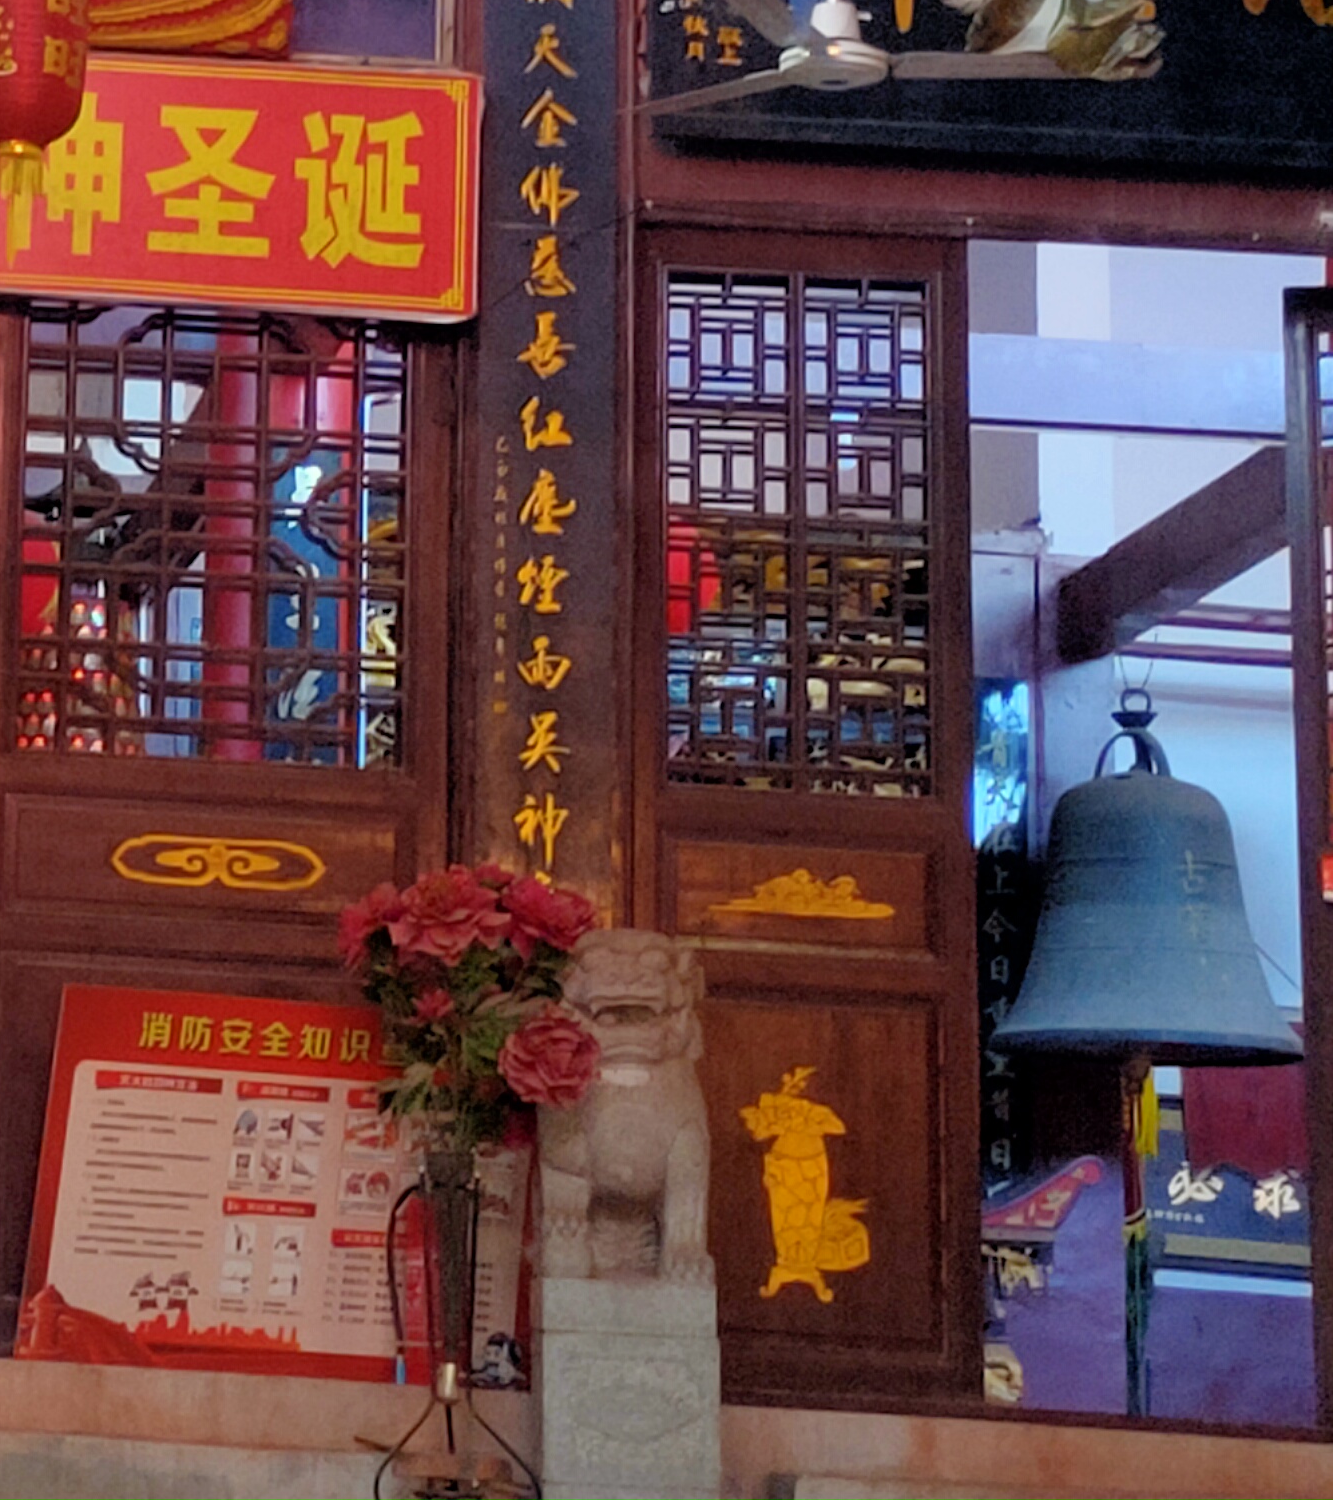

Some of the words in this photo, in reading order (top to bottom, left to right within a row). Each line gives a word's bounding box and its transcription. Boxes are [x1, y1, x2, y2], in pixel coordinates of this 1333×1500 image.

[138, 1011, 373, 1064] 消防安全知识
